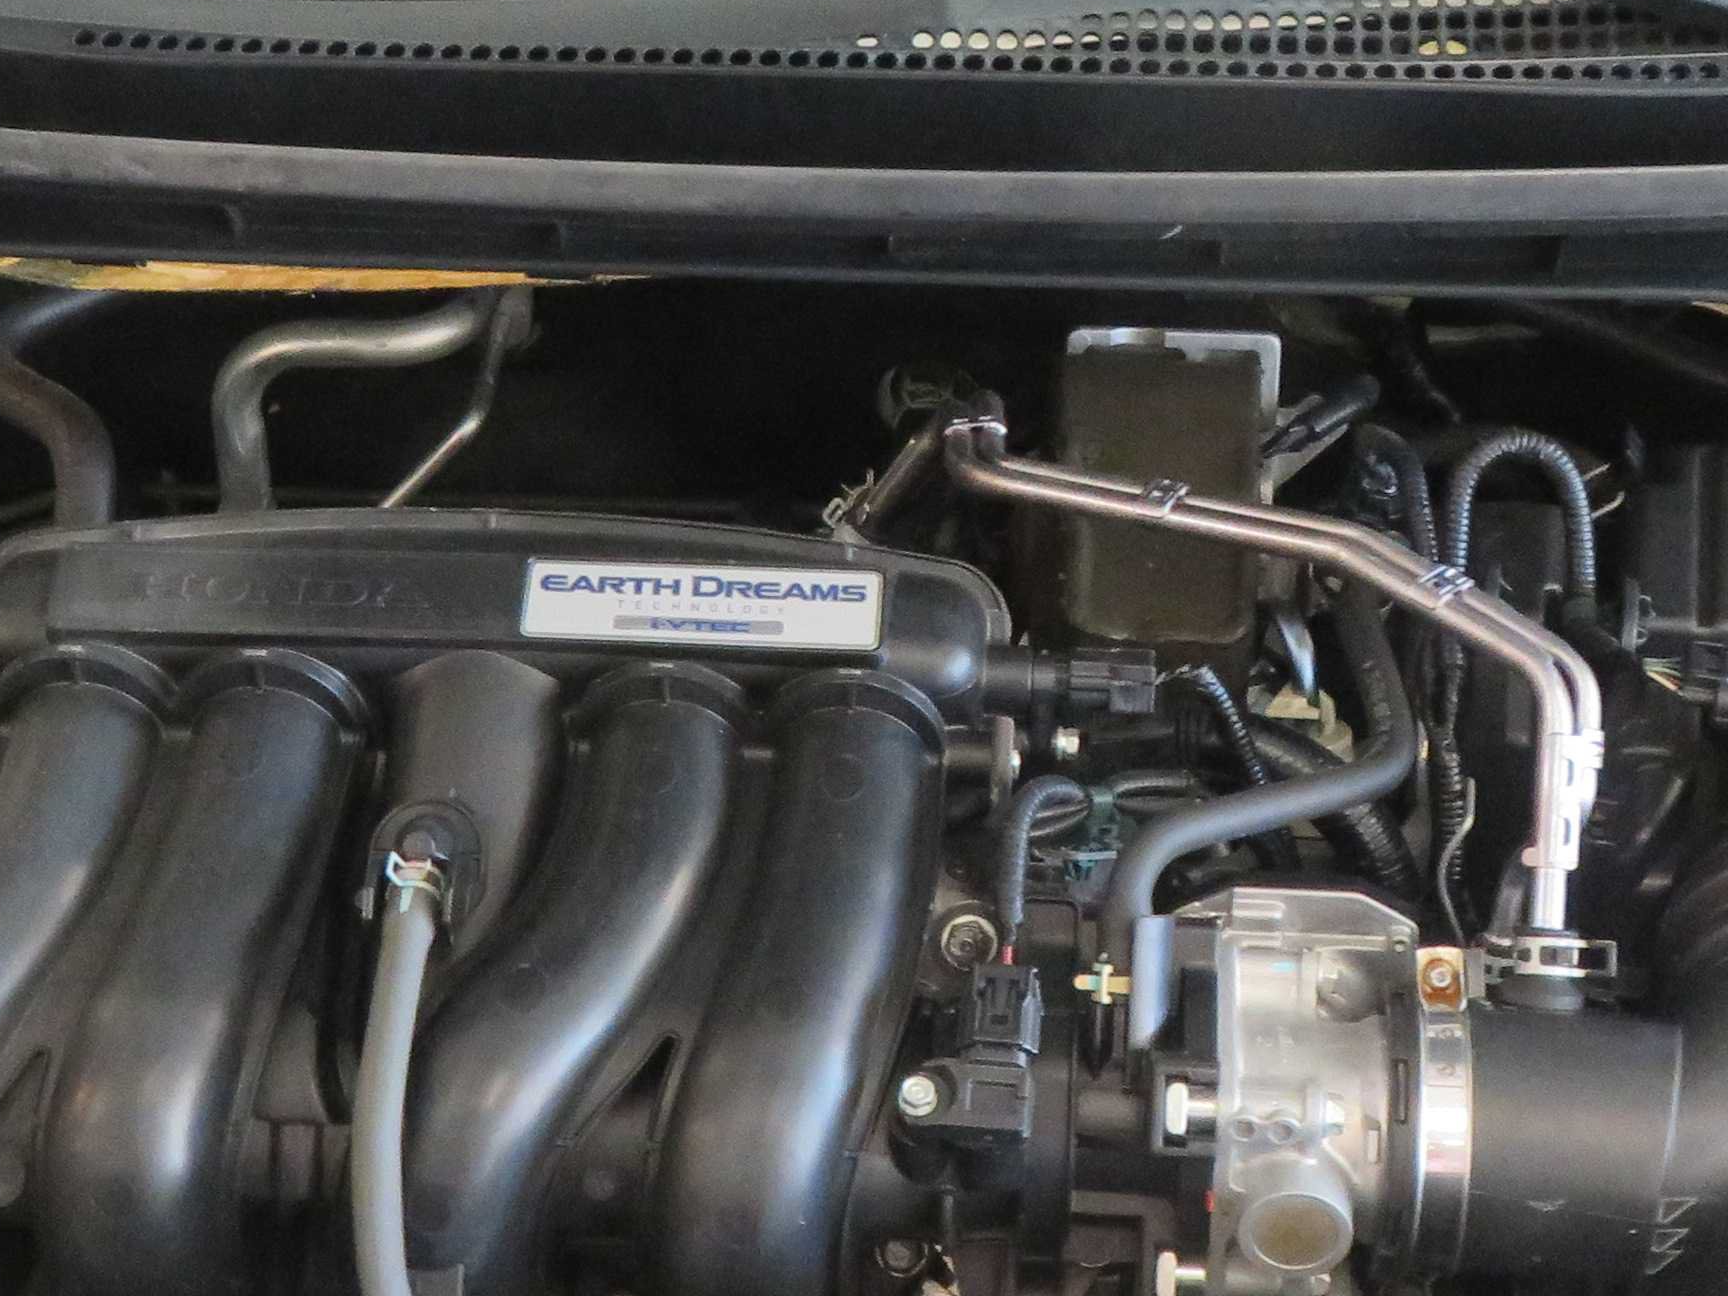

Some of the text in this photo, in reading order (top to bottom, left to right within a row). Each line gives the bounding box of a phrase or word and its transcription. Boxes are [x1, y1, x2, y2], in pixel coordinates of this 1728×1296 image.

[540, 574, 867, 603] EARTH DREAMS
[617, 599, 786, 614] TECHNOLOGY
